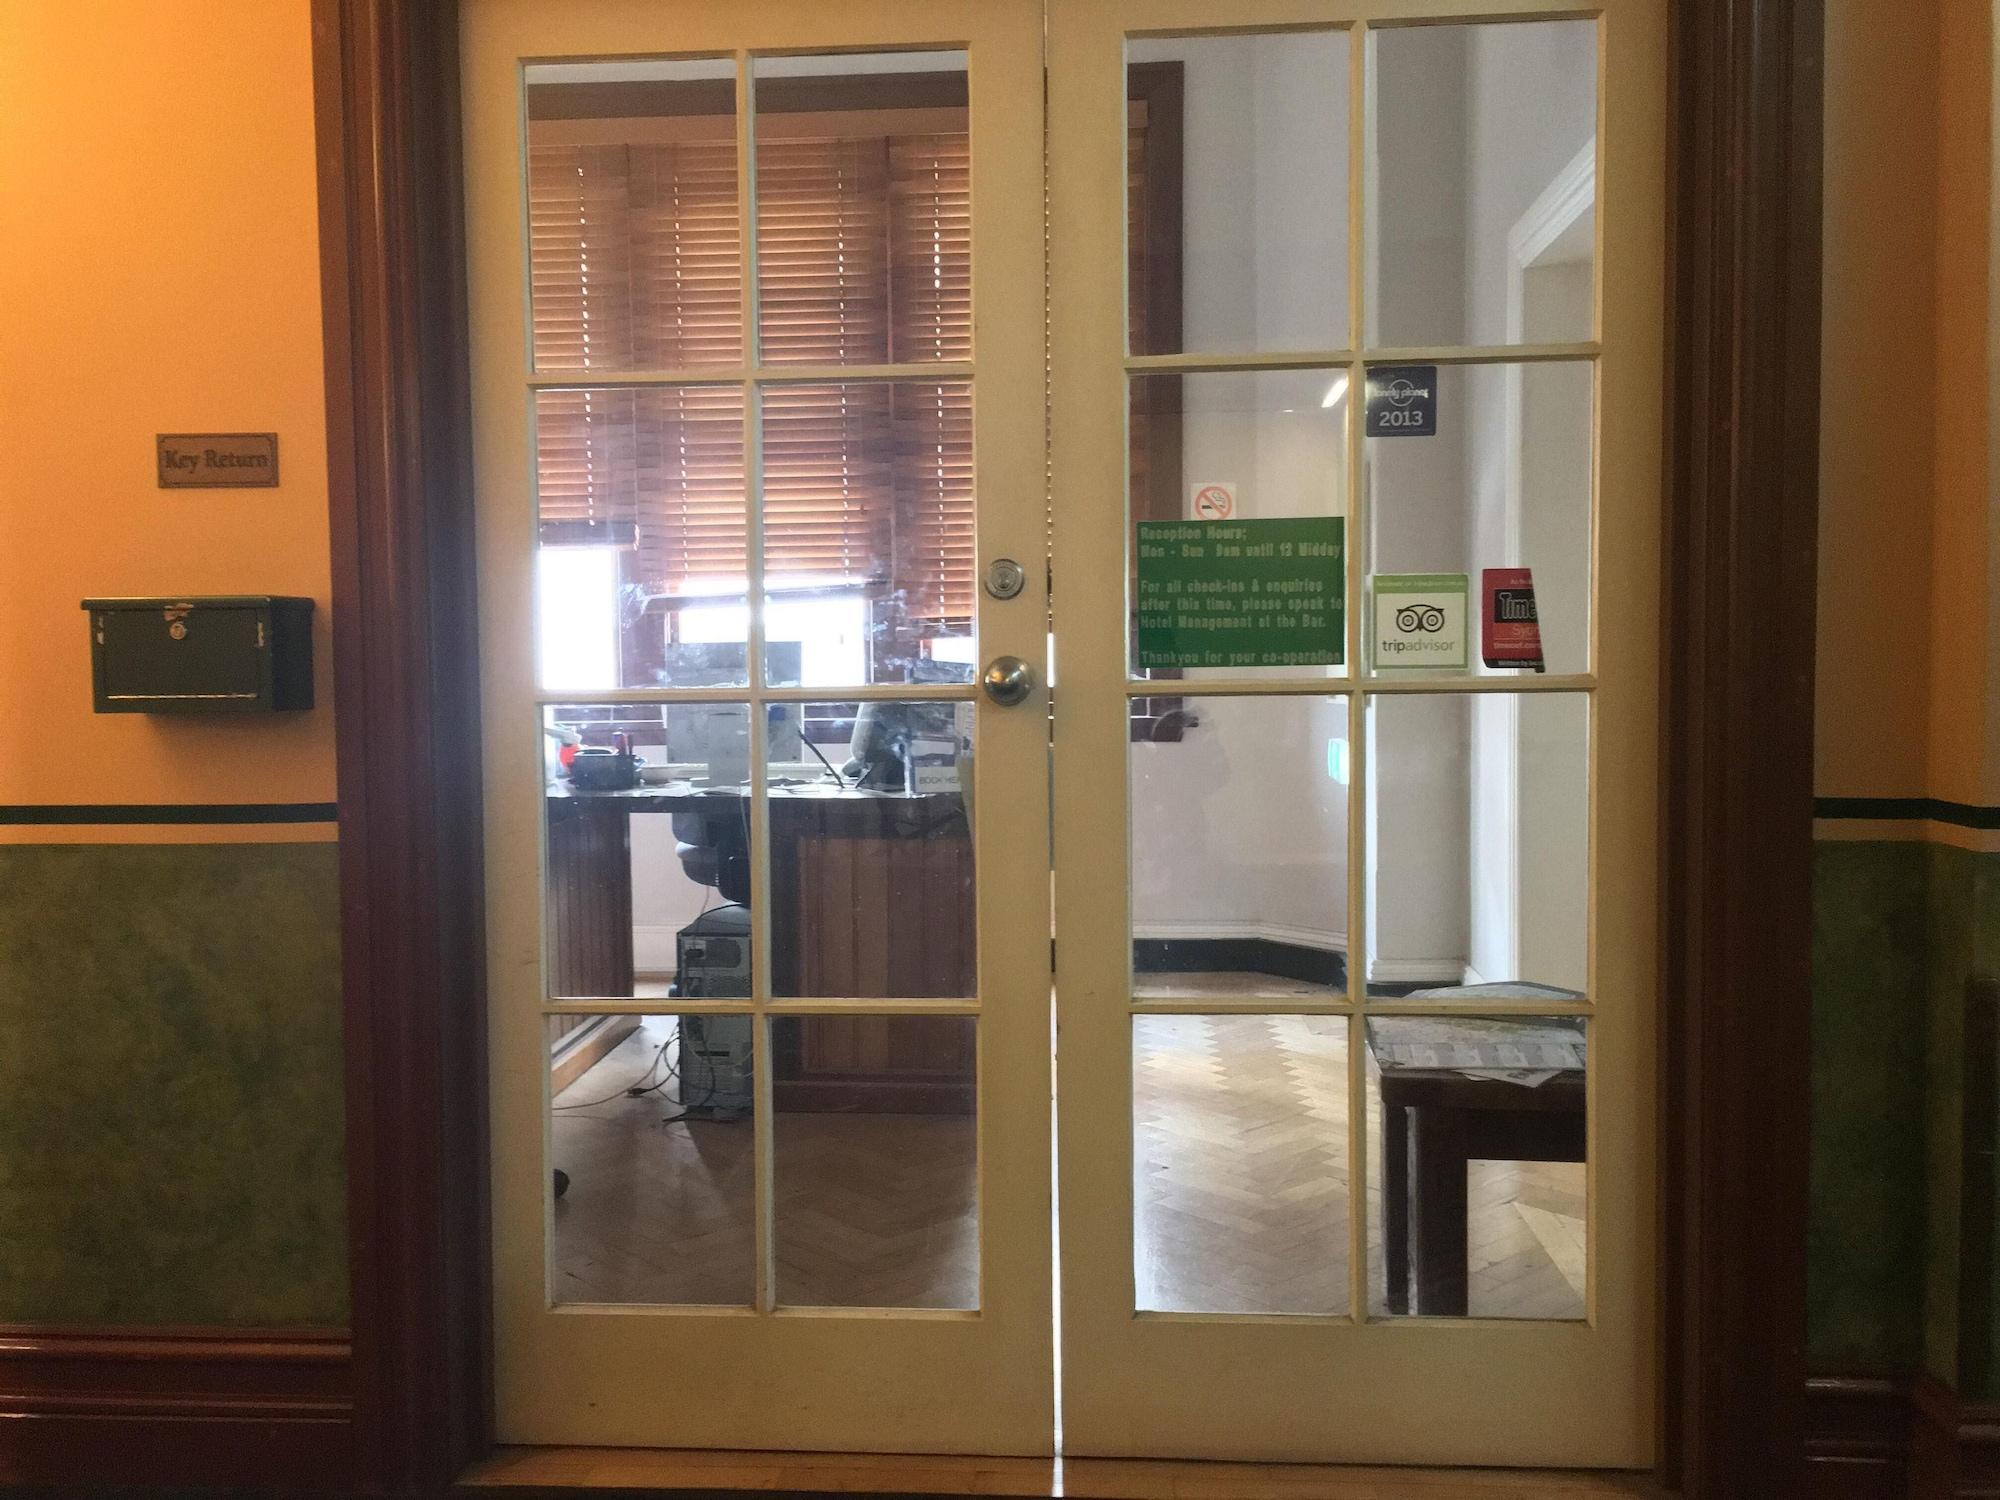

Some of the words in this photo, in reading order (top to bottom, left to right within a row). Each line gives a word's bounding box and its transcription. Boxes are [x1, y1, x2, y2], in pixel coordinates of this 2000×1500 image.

[1379, 411, 1424, 427] 2013
[165, 449, 200, 474] Key
[204, 448, 270, 468] Return
[1140, 527, 1201, 542] Reception
[1182, 544, 1204, 557] Sun
[1246, 543, 1274, 557] until
[1280, 542, 1292, 557] 12
[1298, 542, 1341, 558] Midday
[1140, 580, 1161, 593] For
[1166, 579, 1182, 593] all
[1187, 579, 1245, 593] check-ins
[1266, 578, 1323, 594] enquiries
[1140, 598, 1171, 611] after
[1176, 598, 1200, 611] this
[1206, 597, 1236, 612] time,
[1242, 597, 1282, 613] please
[1288, 597, 1324, 613] speak
[1140, 616, 1172, 629] Hotel
[1178, 615, 1252, 631] Management
[1258, 615, 1271, 628] at
[1277, 614, 1300, 628] the
[1382, 637, 1456, 654] tripadvisor
[1205, 650, 1223, 664] for
[1229, 652, 1256, 666] your
